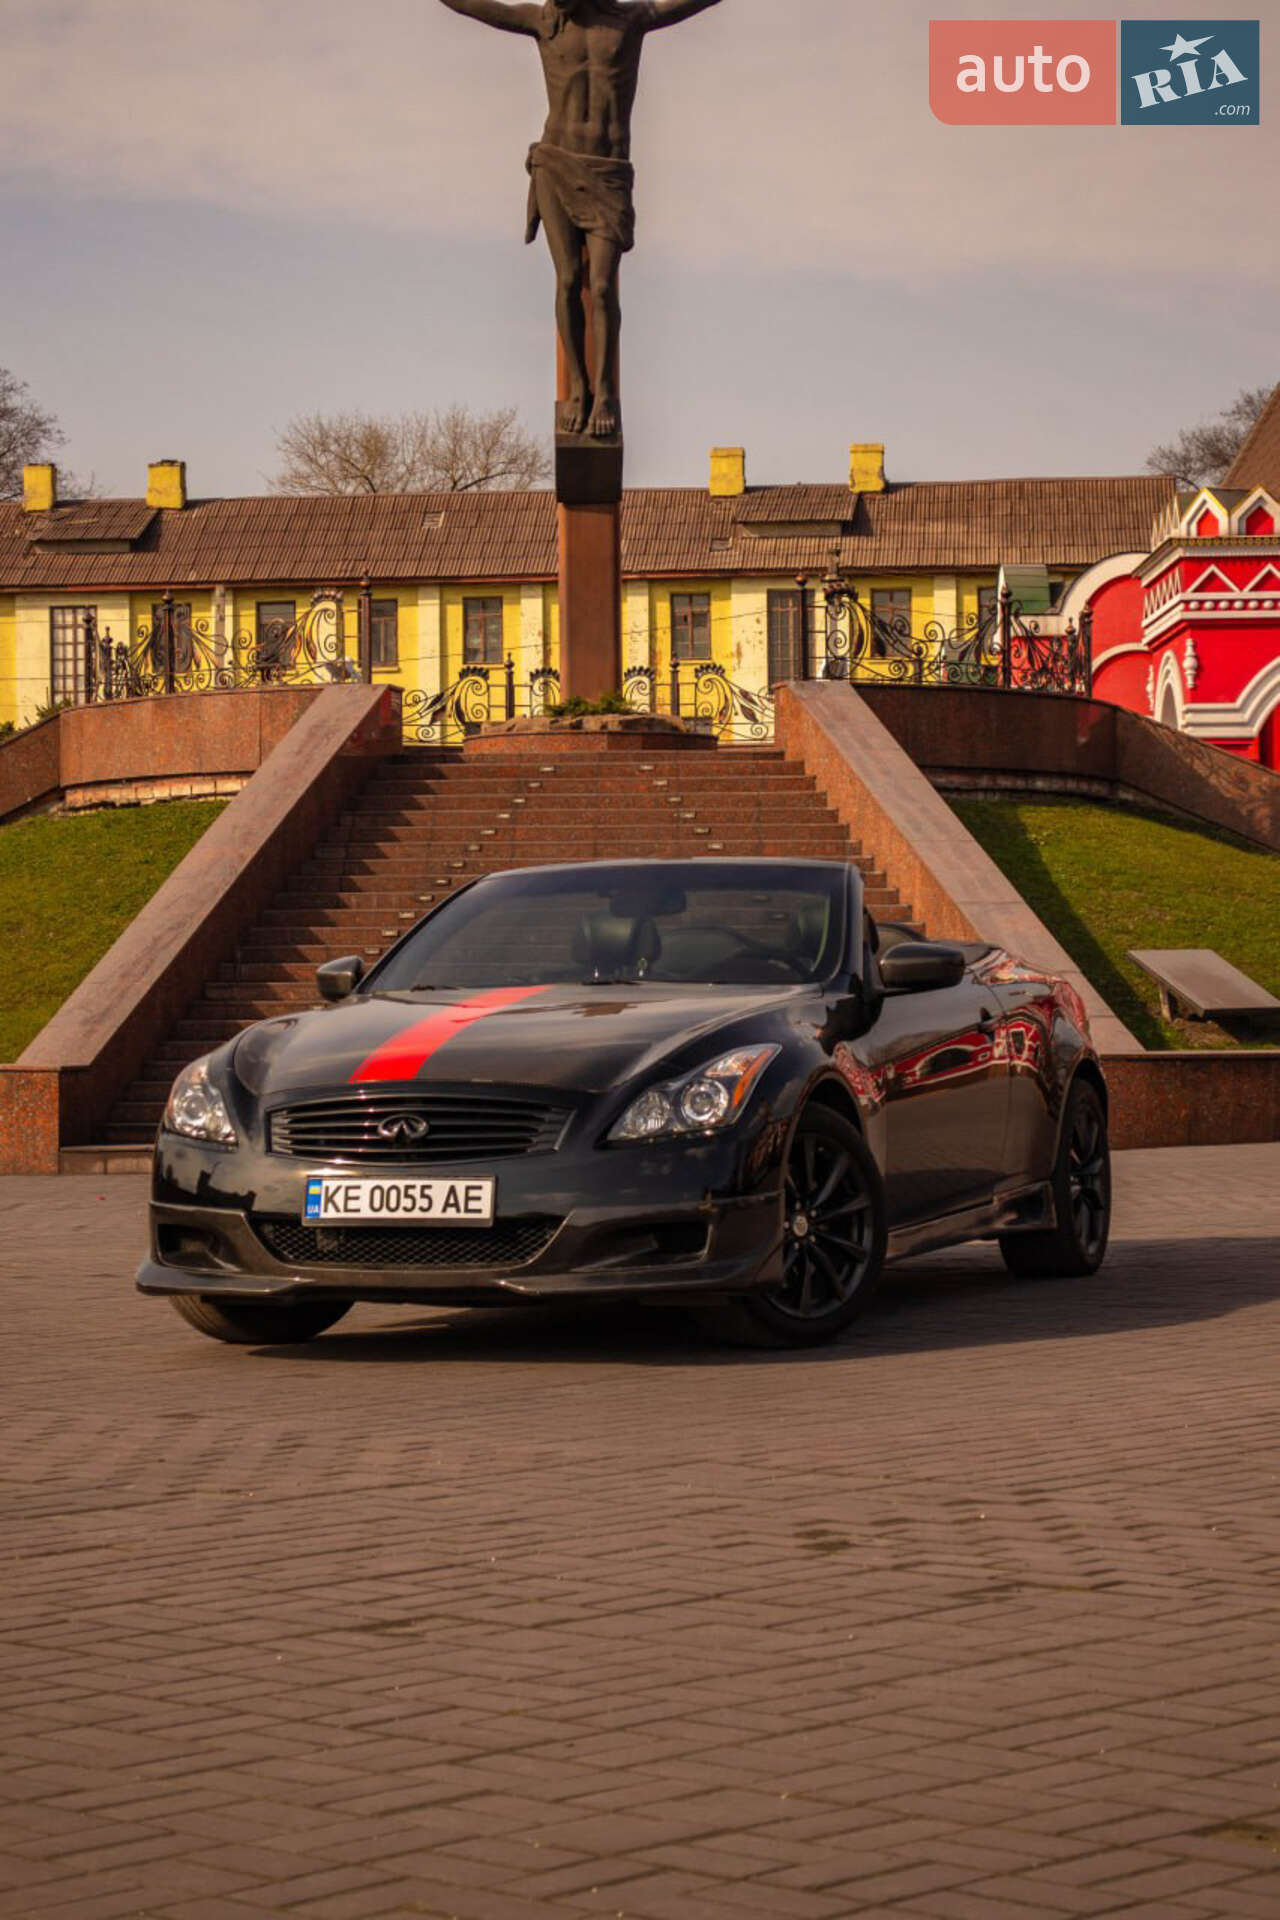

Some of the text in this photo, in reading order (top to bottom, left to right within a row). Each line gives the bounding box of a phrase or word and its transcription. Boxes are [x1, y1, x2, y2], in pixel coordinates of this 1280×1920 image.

[323, 1185, 483, 1214] KE 0055 AE
